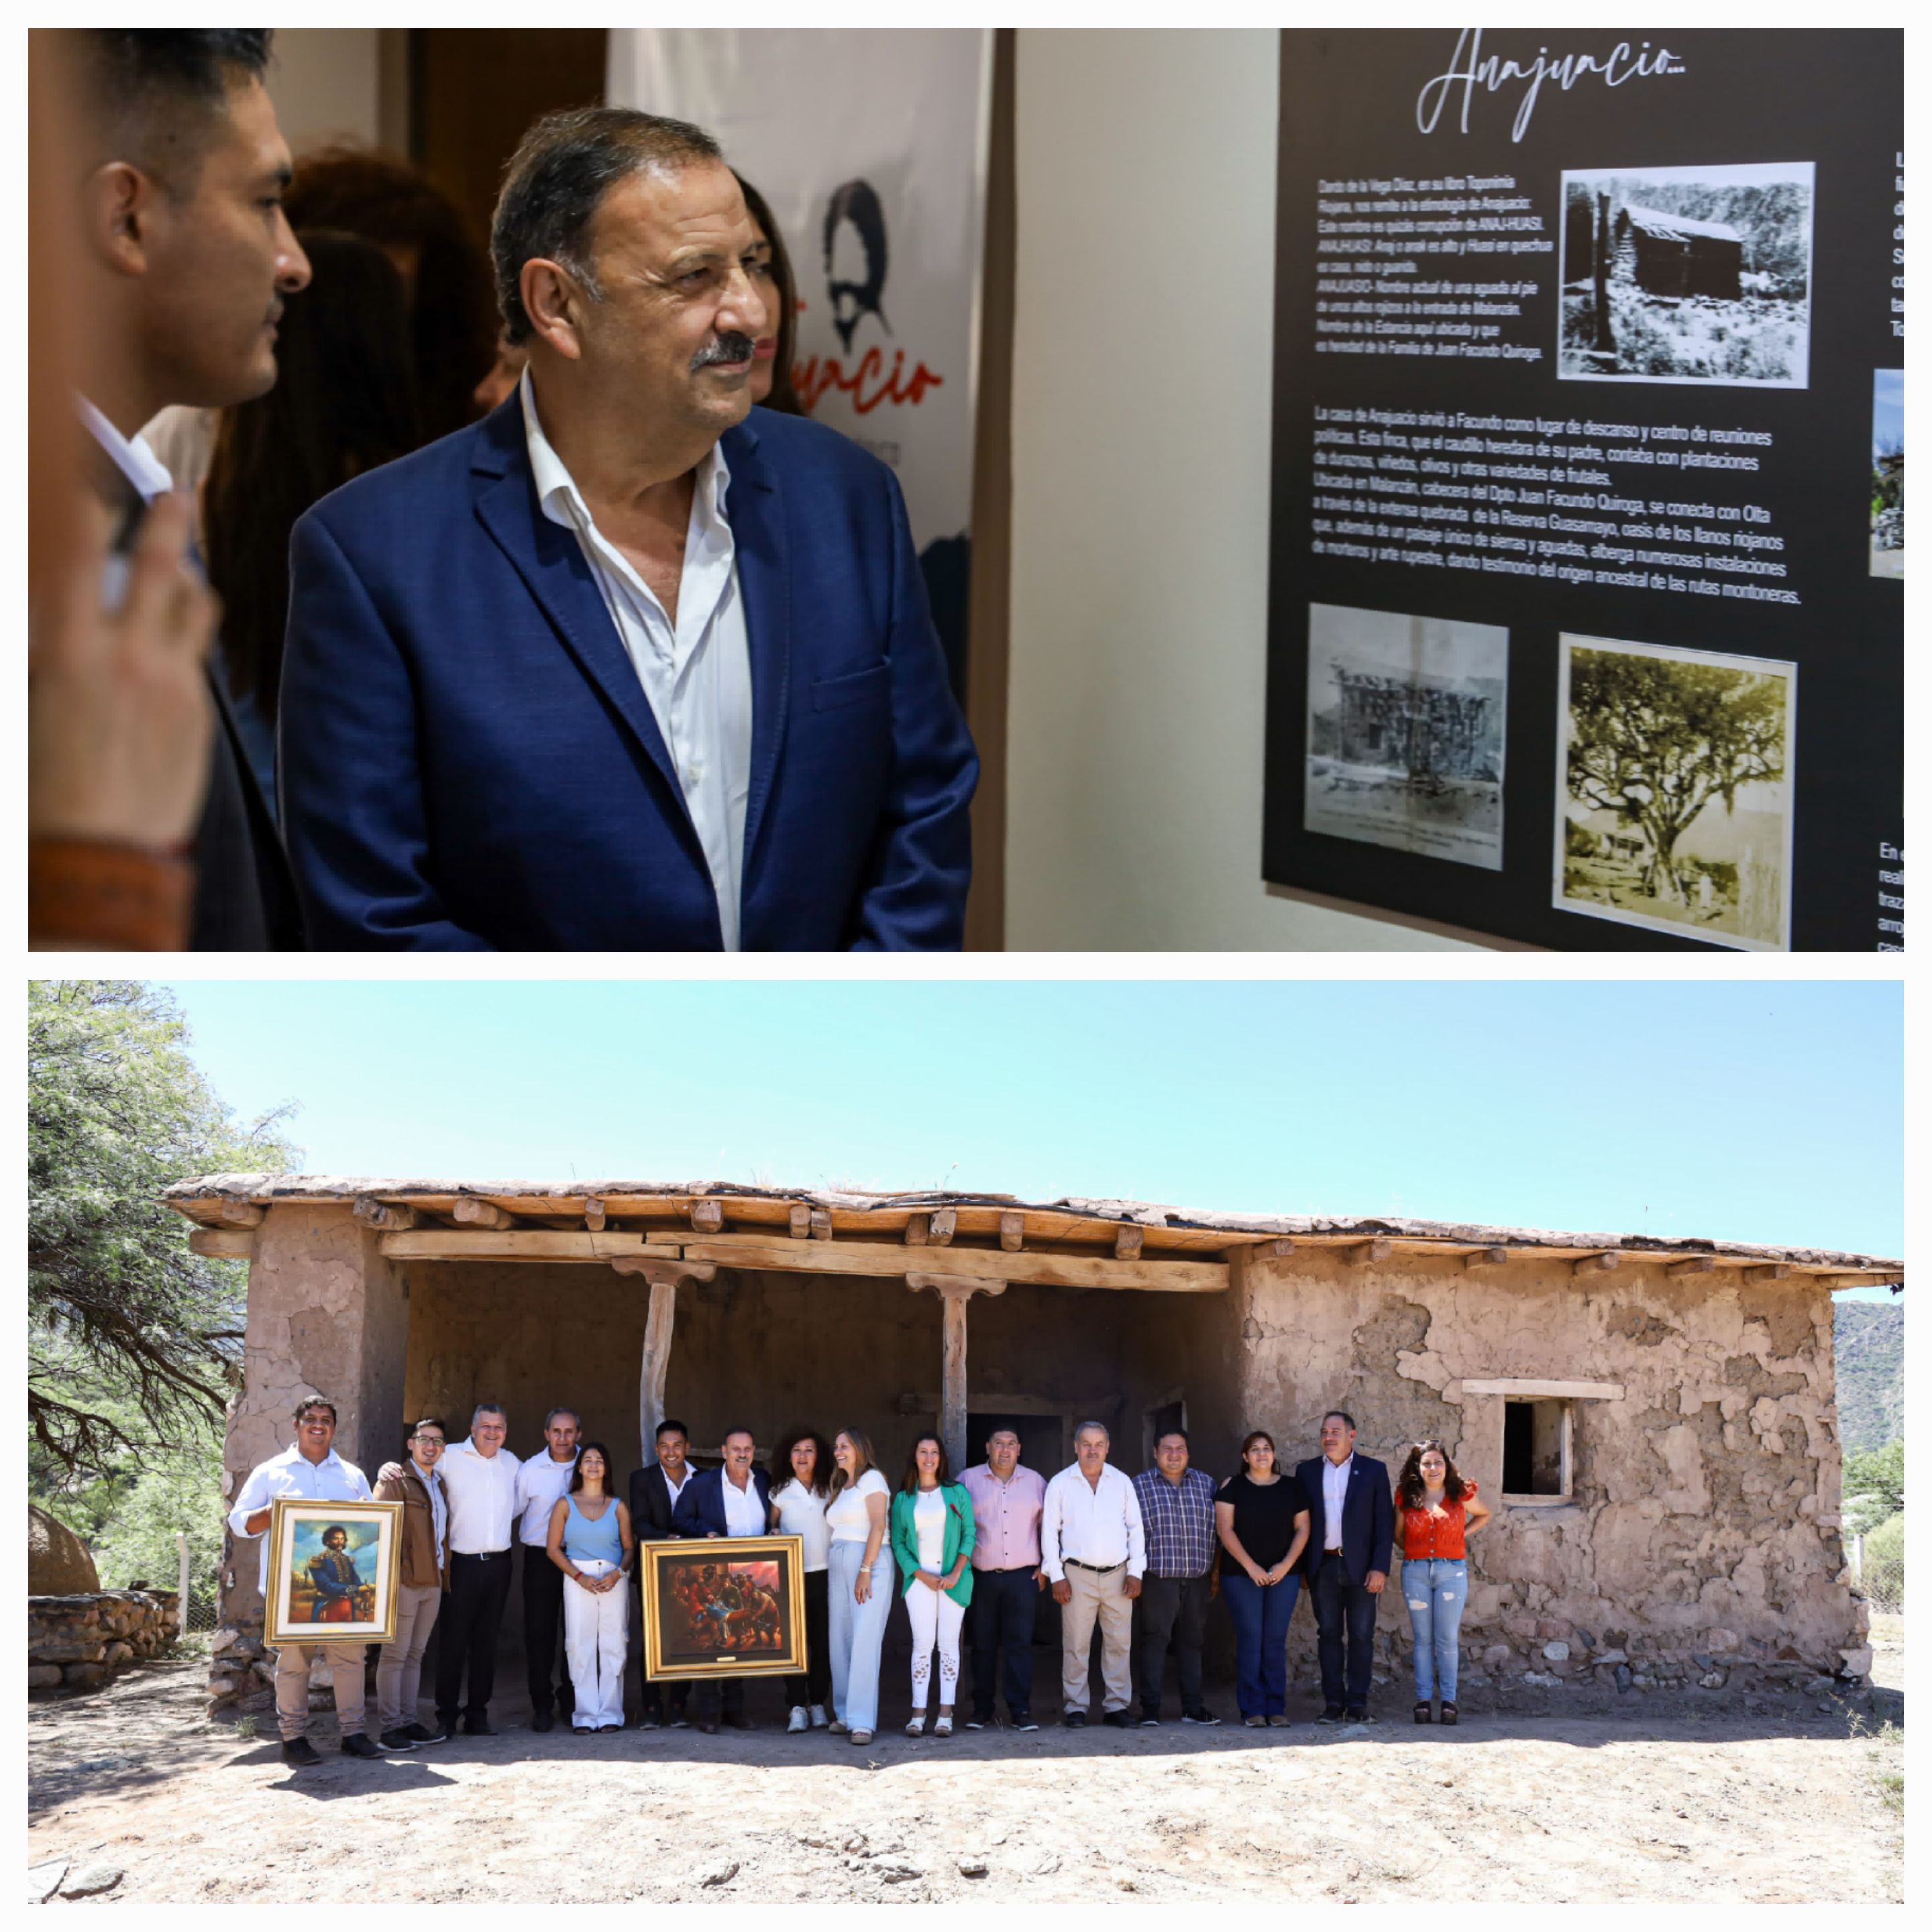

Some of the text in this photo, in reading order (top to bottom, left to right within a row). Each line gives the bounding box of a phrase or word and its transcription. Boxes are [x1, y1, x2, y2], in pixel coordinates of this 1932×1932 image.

[1460, 342, 1501, 358] Facundo
[1315, 406, 1328, 420] La
[1330, 409, 1353, 421] casa
[1354, 409, 1367, 422] de
[1447, 416, 1455, 427] a
[1457, 413, 1503, 430] Facundo
[1504, 419, 1535, 431] como
[1536, 417, 1565, 437] lugar
[1566, 419, 1582, 434] de
[1583, 420, 1639, 437] descanso
[1641, 427, 1649, 442] y
[1651, 425, 1689, 440] centro
[1690, 425, 1707, 441] de
[1709, 428, 1772, 445] reuniones
[1314, 451, 1328, 464] de
[1421, 458, 1450, 474] olivos
[1452, 463, 1460, 478] y
[1460, 462, 1488, 476] otras
[1489, 464, 1548, 480] variedades
[1550, 467, 1565, 482] de
[1567, 467, 1611, 485] frutales.
[1358, 429, 1382, 445] Esta
[1411, 437, 1432, 451] que
[1432, 435, 1443, 449] el
[1444, 437, 1485, 452] caudillo
[1486, 438, 1534, 455] heredara
[1536, 441, 1551, 456] de
[1552, 445, 1567, 458] su
[1568, 444, 1605, 462] padre,
[1607, 447, 1654, 464] contaba
[1656, 452, 1678, 464] con
[1681, 450, 1759, 470] plantaciones
[1354, 478, 1368, 489] en
[1422, 482, 1470, 498] cabecera
[1471, 484, 1488, 499] del
[1517, 488, 1544, 504] Juan
[1547, 489, 1596, 508] Facundo
[1597, 494, 1647, 516] Quiroga,
[1650, 502, 1665, 514] se
[1666, 503, 1715, 518] conecta
[1717, 507, 1740, 520] con
[1352, 498, 1366, 513] de
[1367, 499, 1378, 513] la
[1419, 505, 1468, 521] quebrada
[1473, 508, 1488, 523] de
[1489, 509, 1500, 524] la
[1501, 510, 1547, 529] Reserva
[1621, 523, 1654, 538] oasis
[1655, 524, 1672, 540] de
[1674, 525, 1692, 541] los
[1695, 527, 1731, 545] llanos
[1733, 531, 1784, 551] riojanos
[1376, 523, 1389, 537] de
[1405, 526, 1443, 545] paisaje
[1444, 529, 1473, 545] único
[1474, 532, 1489, 547] de
[1490, 536, 1527, 550] sierras
[1528, 540, 1536, 555] y
[1538, 540, 1589, 558] aguadas,
[1591, 543, 1634, 565] alberga
[1636, 550, 1703, 568] numerosas
[1705, 553, 1786, 576] instalaciones
[1371, 547, 1379, 562] y
[1379, 547, 1400, 561] arte
[1447, 553, 1481, 570] dando
[1482, 556, 1538, 575] testimonio
[1538, 561, 1556, 577] del
[1558, 564, 1593, 584] origen
[1595, 571, 1648, 587] ancestral
[1650, 574, 1666, 589] de
[1668, 574, 1686, 592] las
[1688, 579, 1720, 595] rutas
[1722, 584, 1801, 604] montoneras.
